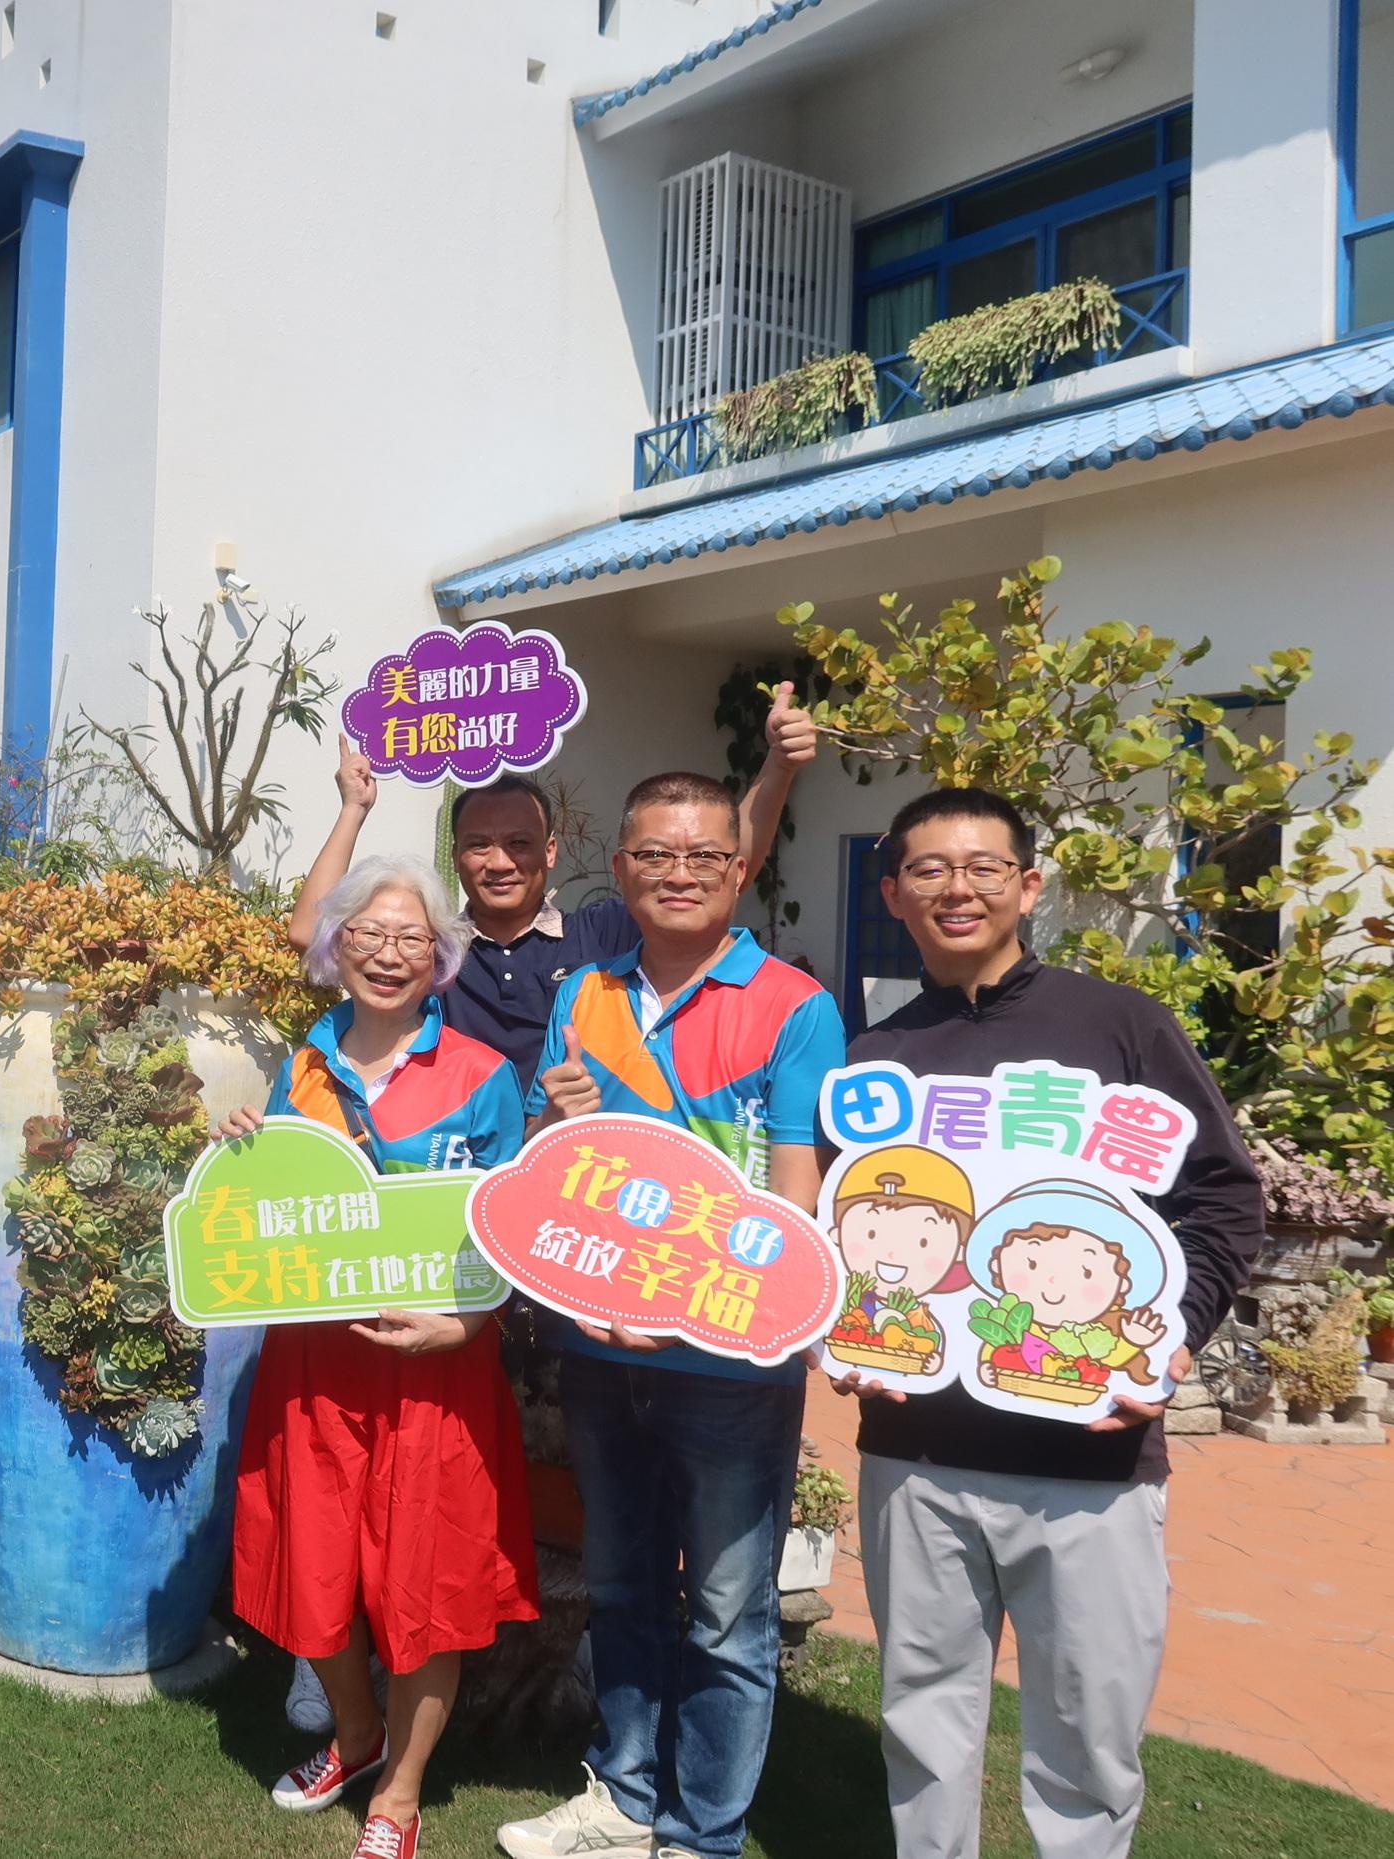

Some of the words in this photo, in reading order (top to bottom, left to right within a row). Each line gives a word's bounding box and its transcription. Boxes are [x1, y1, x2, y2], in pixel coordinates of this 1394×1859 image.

[381, 656, 540, 708] 美麗的力量
[381, 712, 518, 758] 有您尚好
[426, 1133, 443, 1171] TIANW
[831, 1070, 1183, 1184] 田尾青農
[198, 1184, 381, 1244] 春暖花開
[559, 1145, 783, 1266] 花現美好
[203, 1244, 492, 1309] 支持在地花農
[529, 1218, 765, 1336] 綻放幸福
